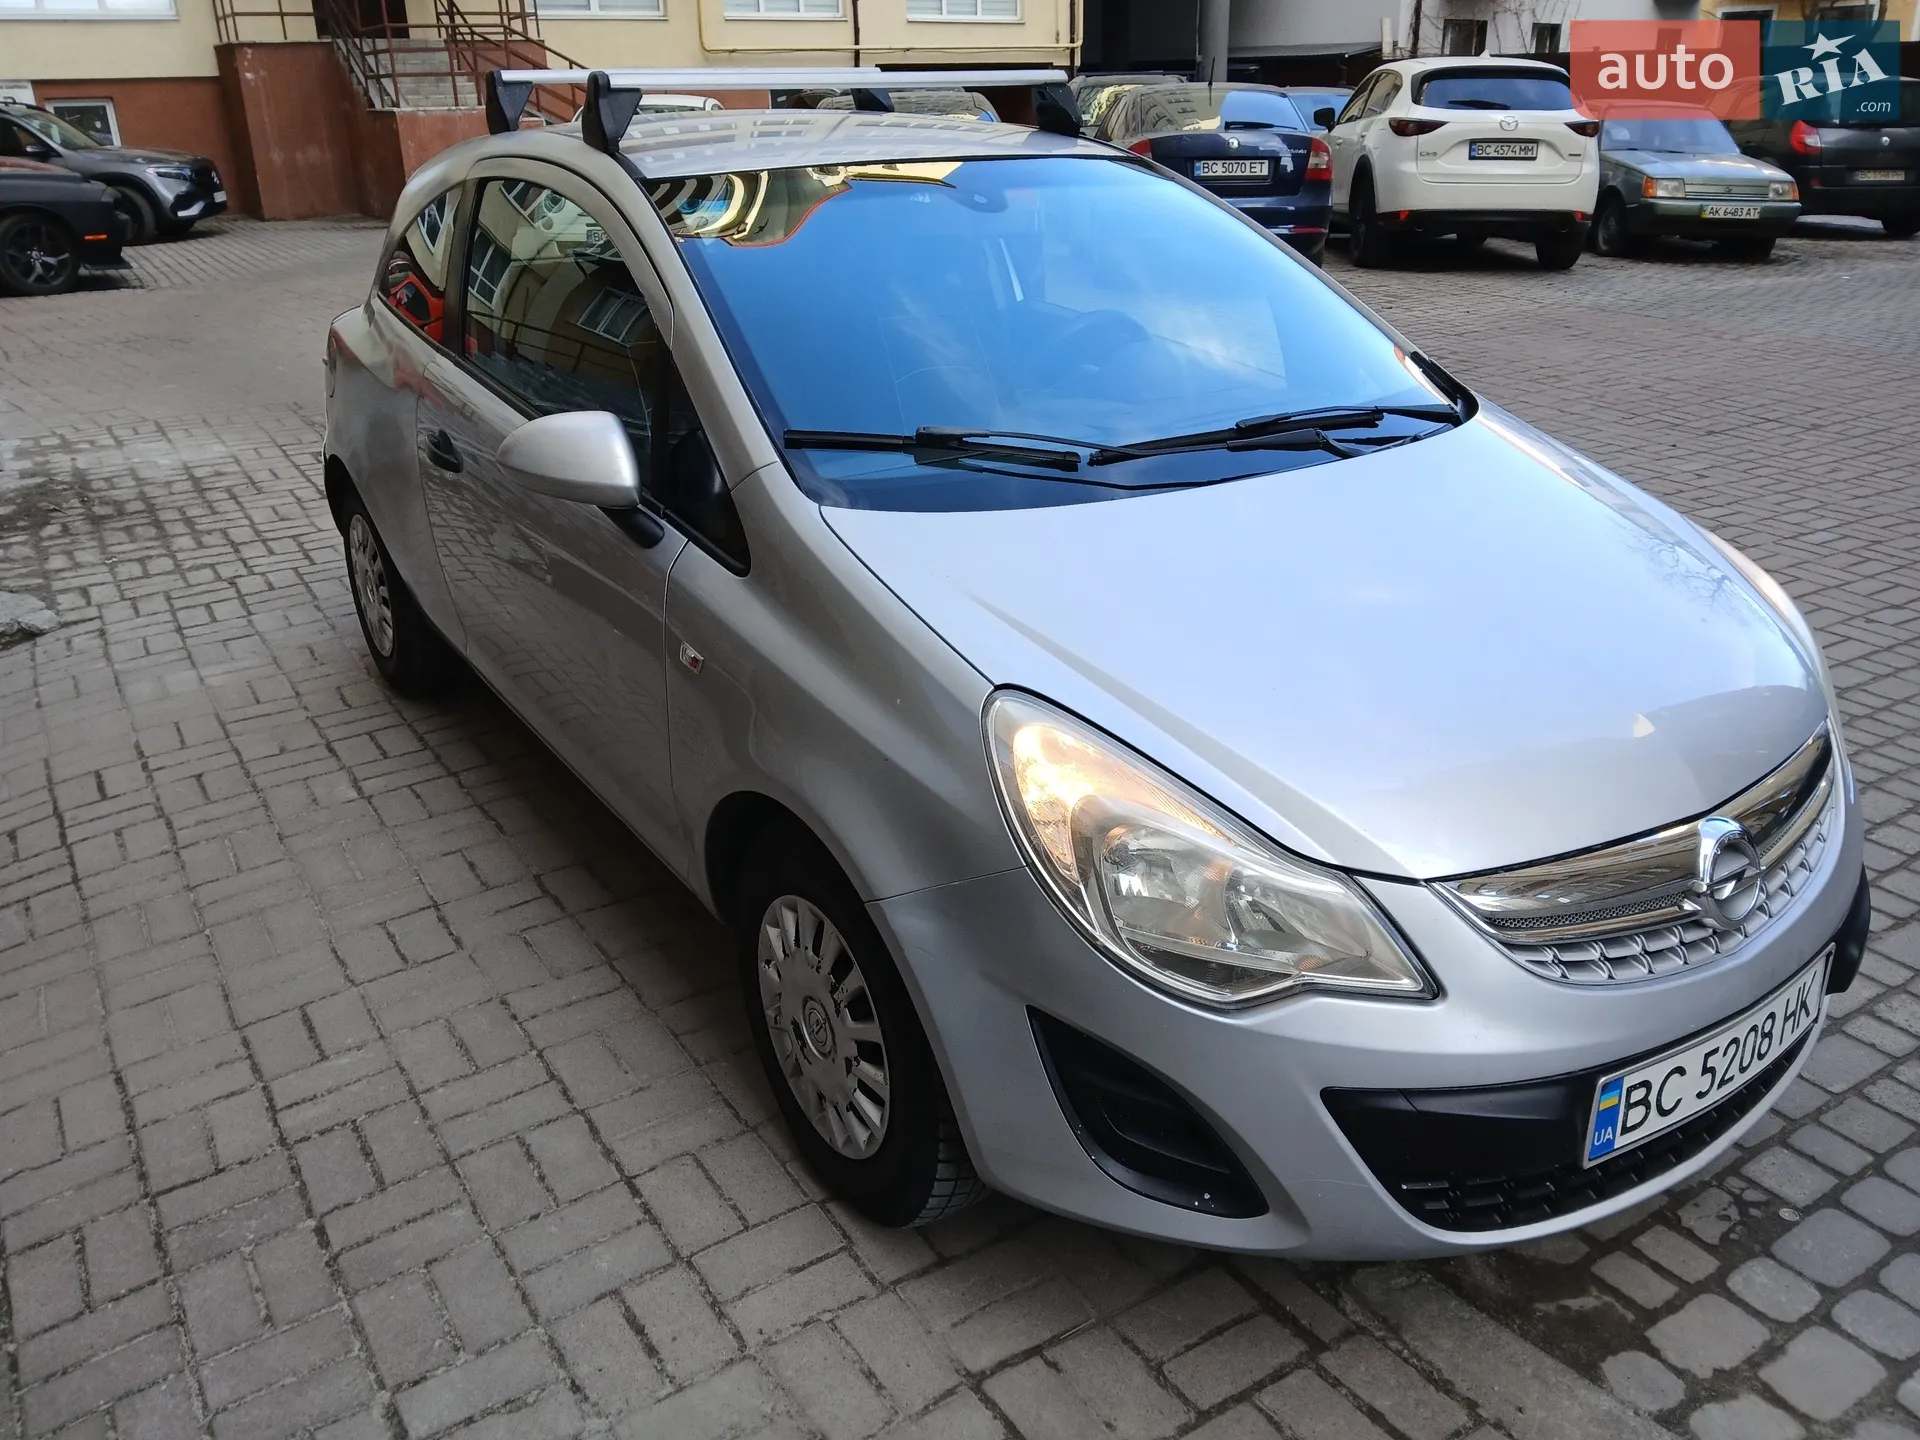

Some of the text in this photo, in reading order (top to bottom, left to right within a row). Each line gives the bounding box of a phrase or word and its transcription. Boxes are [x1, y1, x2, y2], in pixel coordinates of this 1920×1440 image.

[1476, 144, 1534, 156] BC 4574 MM
[1202, 161, 1266, 174] BC 5070 ET
[1708, 206, 1758, 217] AK 6483 AT
[1620, 970, 1818, 1137] BC 5208 HK
[1594, 1126, 1613, 1145] UA
